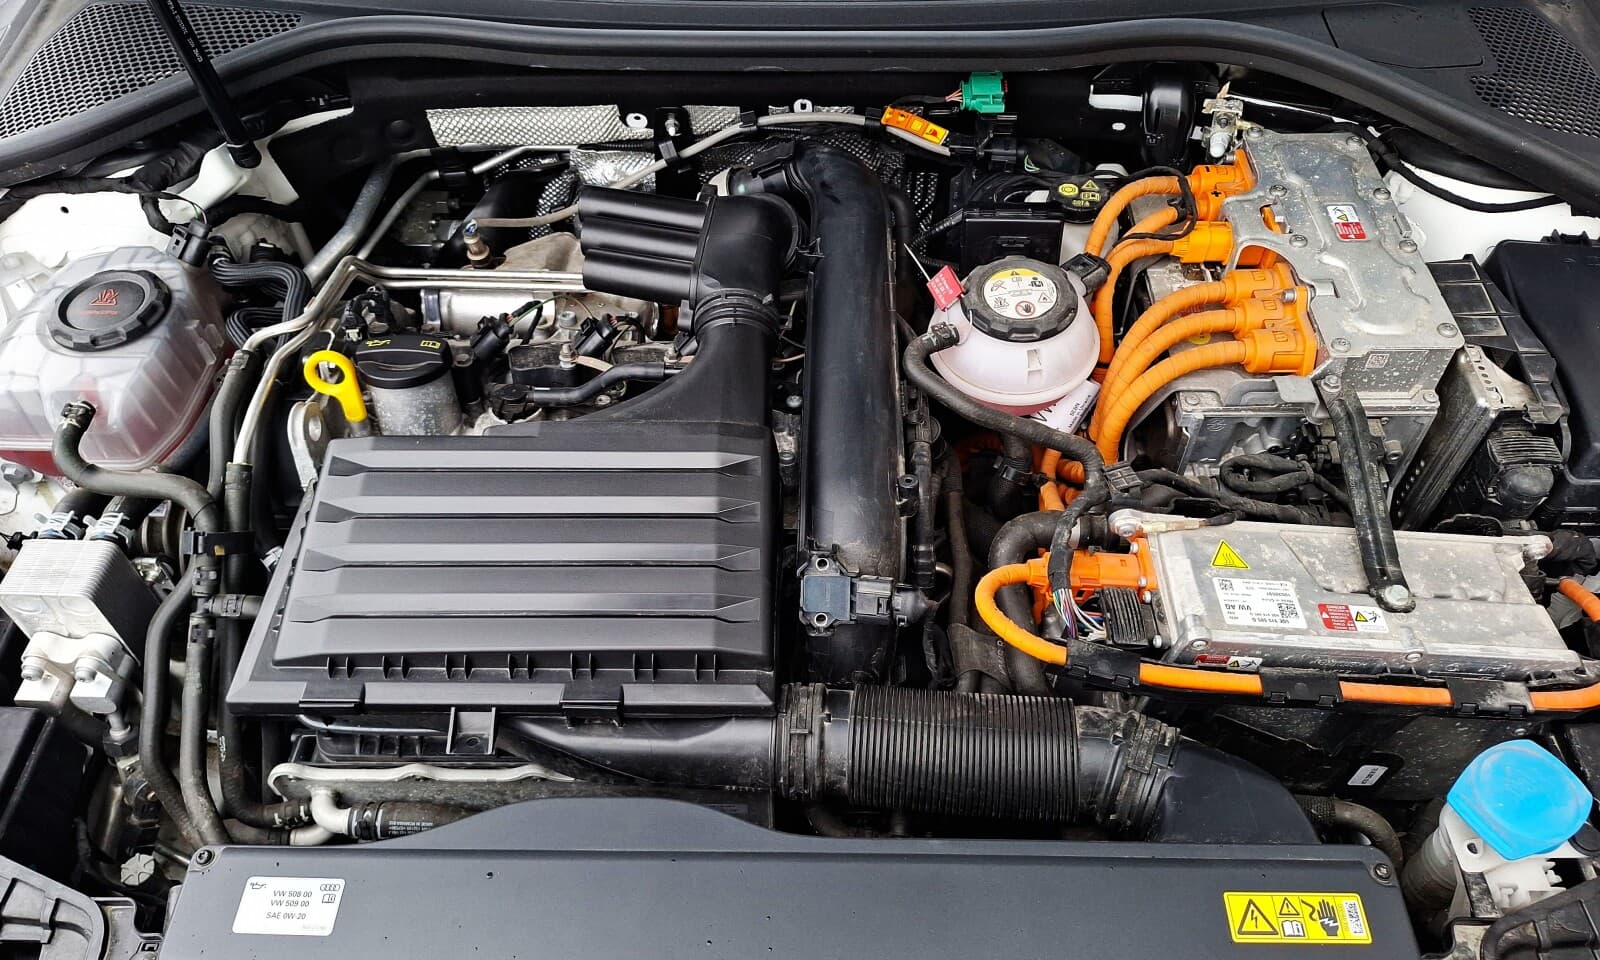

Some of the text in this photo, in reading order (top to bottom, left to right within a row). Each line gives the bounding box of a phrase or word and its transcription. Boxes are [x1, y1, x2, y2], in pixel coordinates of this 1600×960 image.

[1238, 603, 1252, 611] VW
[273, 890, 313, 898] VW 508 00
[265, 911, 282, 920] SAE
